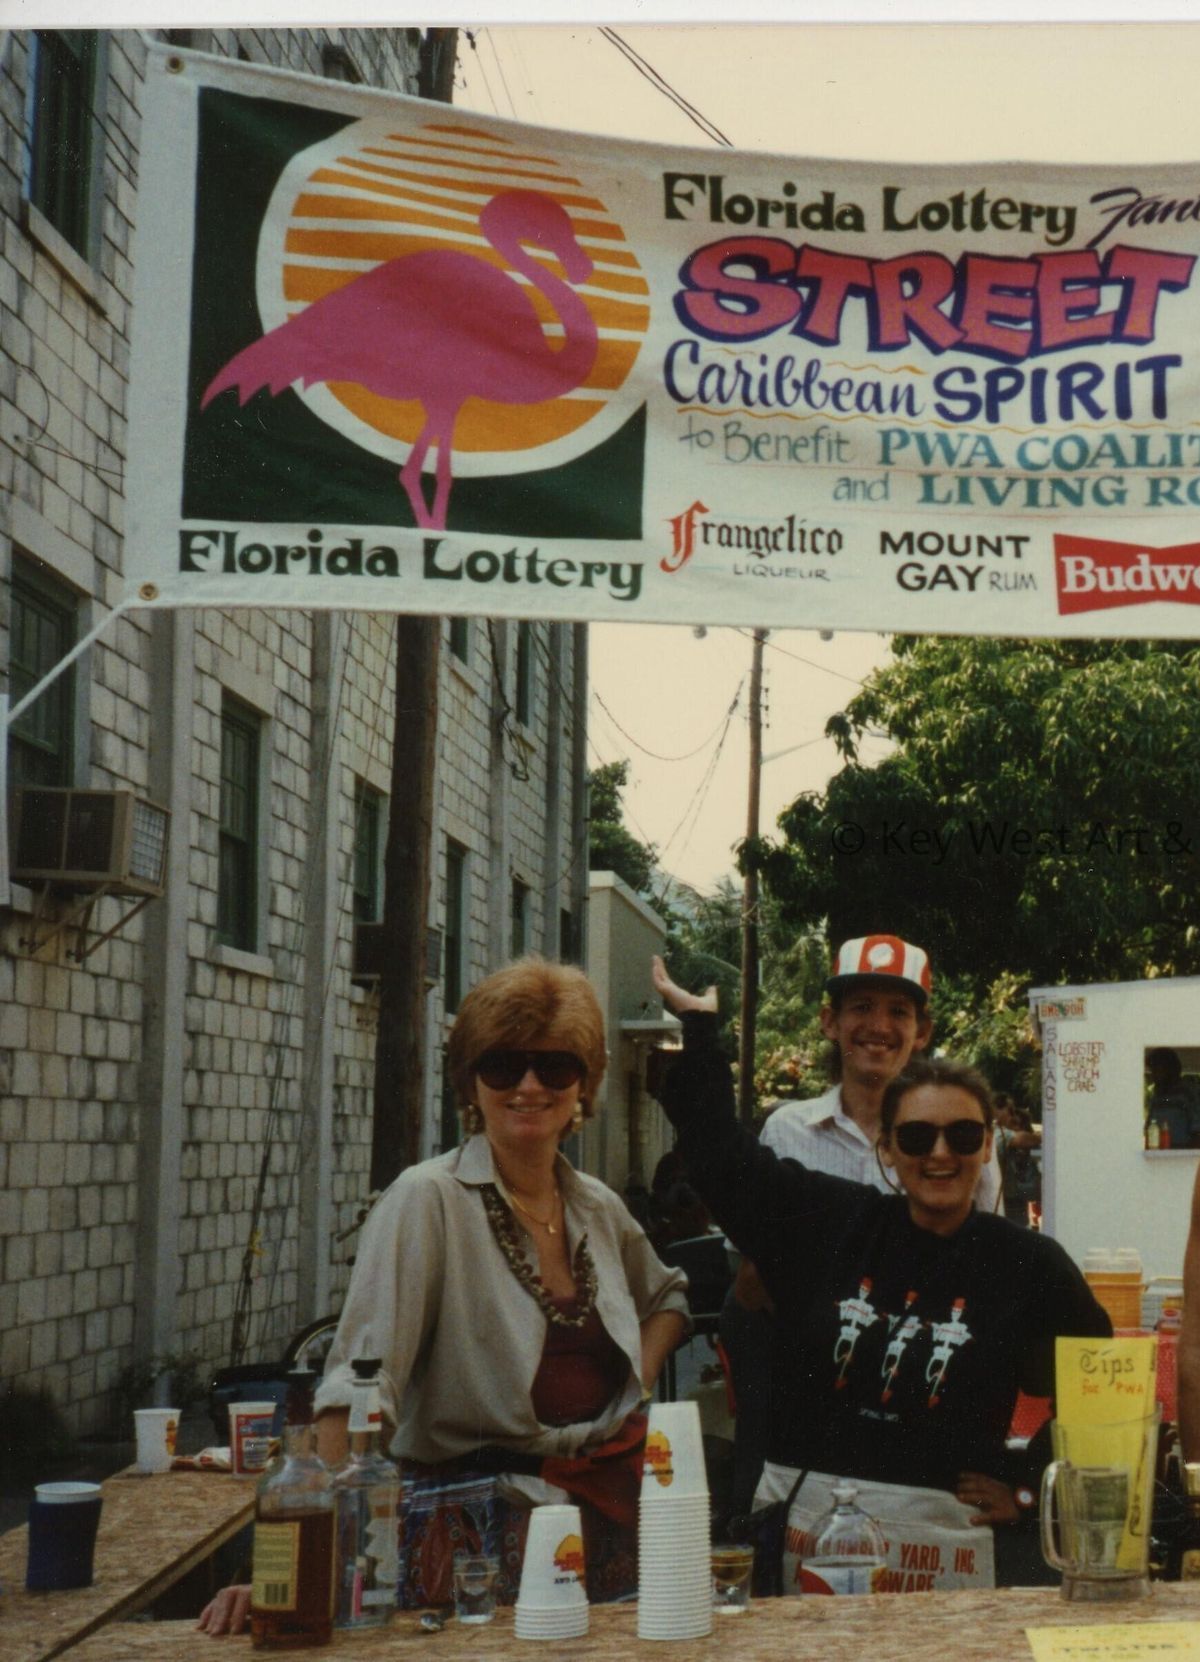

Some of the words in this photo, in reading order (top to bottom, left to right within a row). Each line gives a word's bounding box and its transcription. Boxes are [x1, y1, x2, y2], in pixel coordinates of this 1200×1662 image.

[662, 172, 866, 232] Florida
[882, 186, 1077, 246] Lottery
[672, 234, 1197, 364] STREET
[662, 338, 926, 417] Caribbean
[933, 353, 1182, 424] SPIRIT
[679, 415, 714, 455] to
[724, 419, 855, 464] Benefit
[876, 427, 1005, 468] PWA
[833, 473, 889, 502] and
[917, 473, 1128, 508] LIVING
[659, 500, 844, 573] Frangelico
[880, 531, 1030, 559] MOUNT
[178, 528, 400, 578] Florida
[422, 537, 644, 601] Lottery
[733, 562, 830, 581] LIQUEUR
[897, 561, 985, 592] GAY
[989, 571, 1038, 592] RUM
[1058, 1041, 1106, 1056] LOBSTER
[1061, 1055, 1100, 1069] SHRIMP
[1045, 1027, 1057, 1111] SALADS
[1079, 1347, 1135, 1386] Tips
[1115, 1381, 1144, 1395] PWA
[901, 1541, 945, 1575] YARD,
[954, 1546, 979, 1576] INC.
